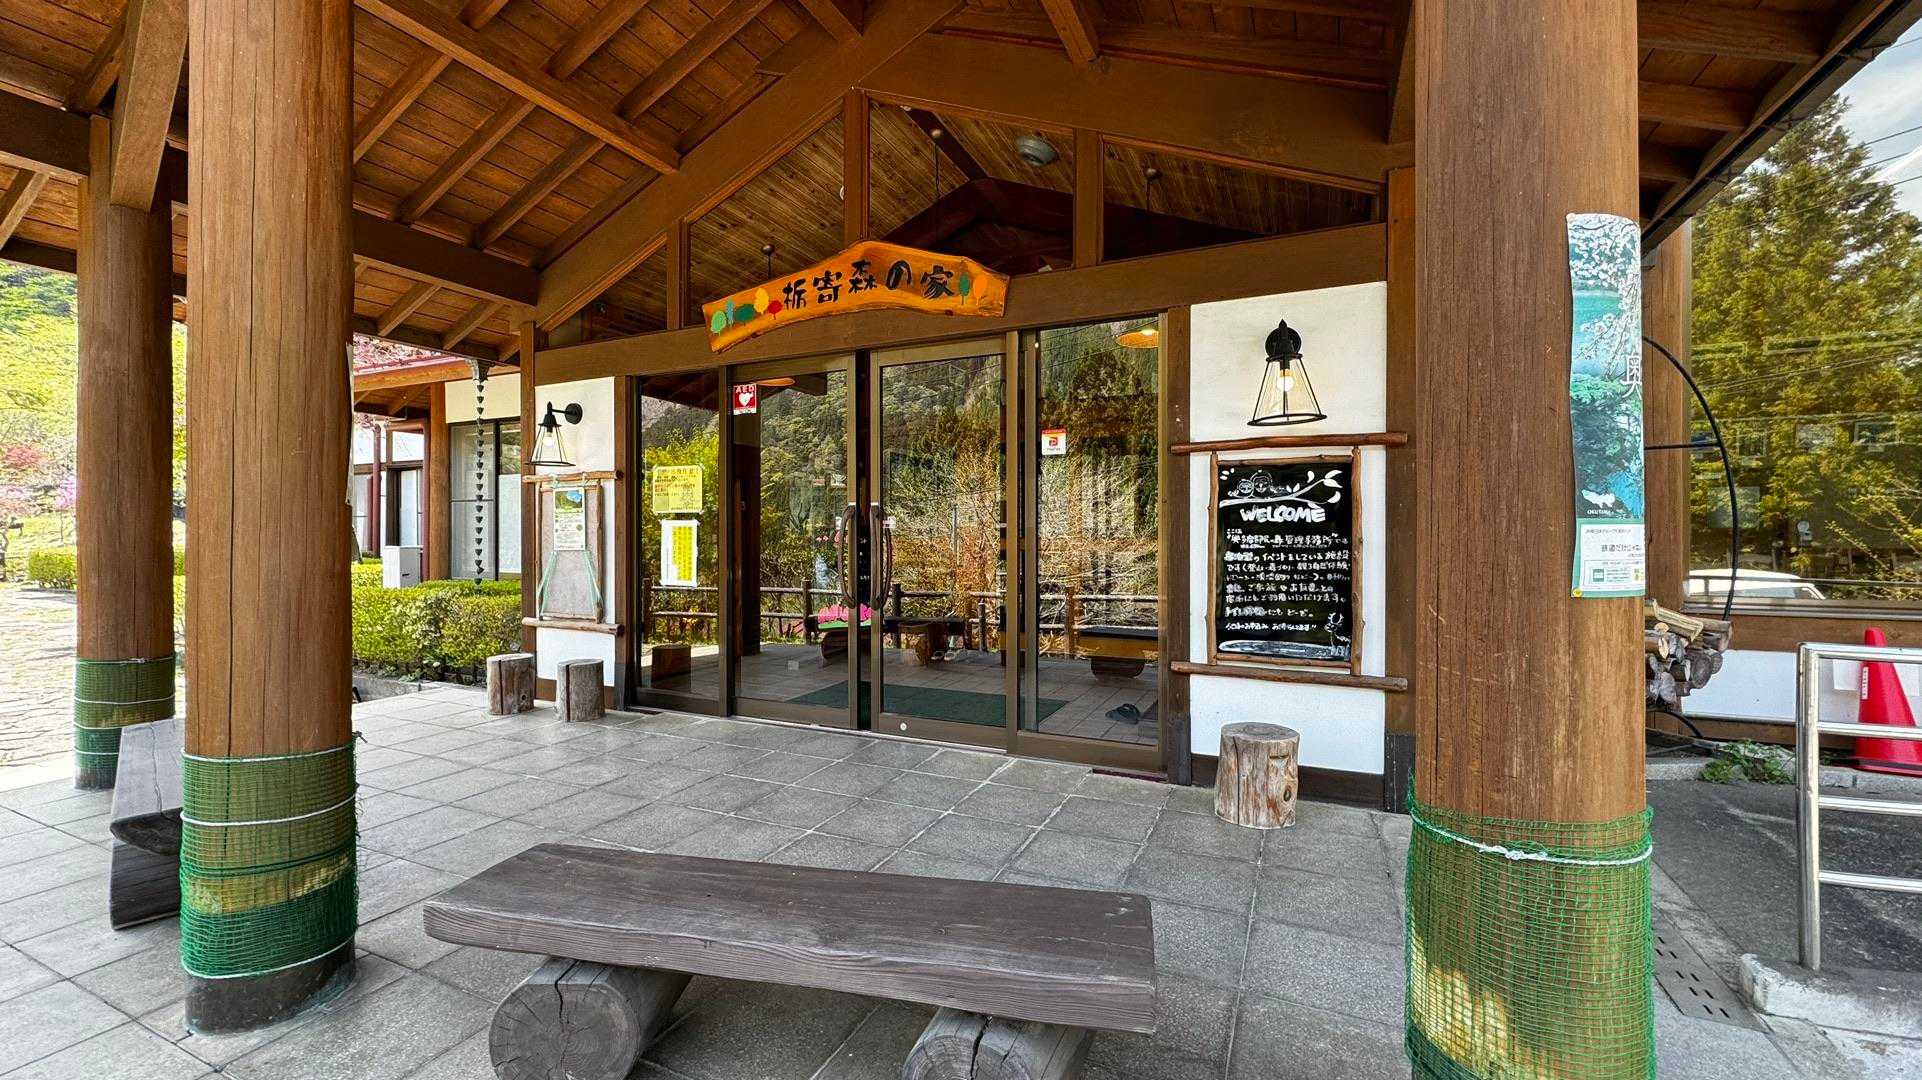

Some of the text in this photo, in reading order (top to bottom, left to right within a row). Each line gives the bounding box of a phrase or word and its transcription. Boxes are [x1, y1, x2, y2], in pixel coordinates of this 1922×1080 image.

[1620, 350, 1642, 401] 奥
[735, 385, 755, 394] AED
[1240, 505, 1326, 522] WELCOME
